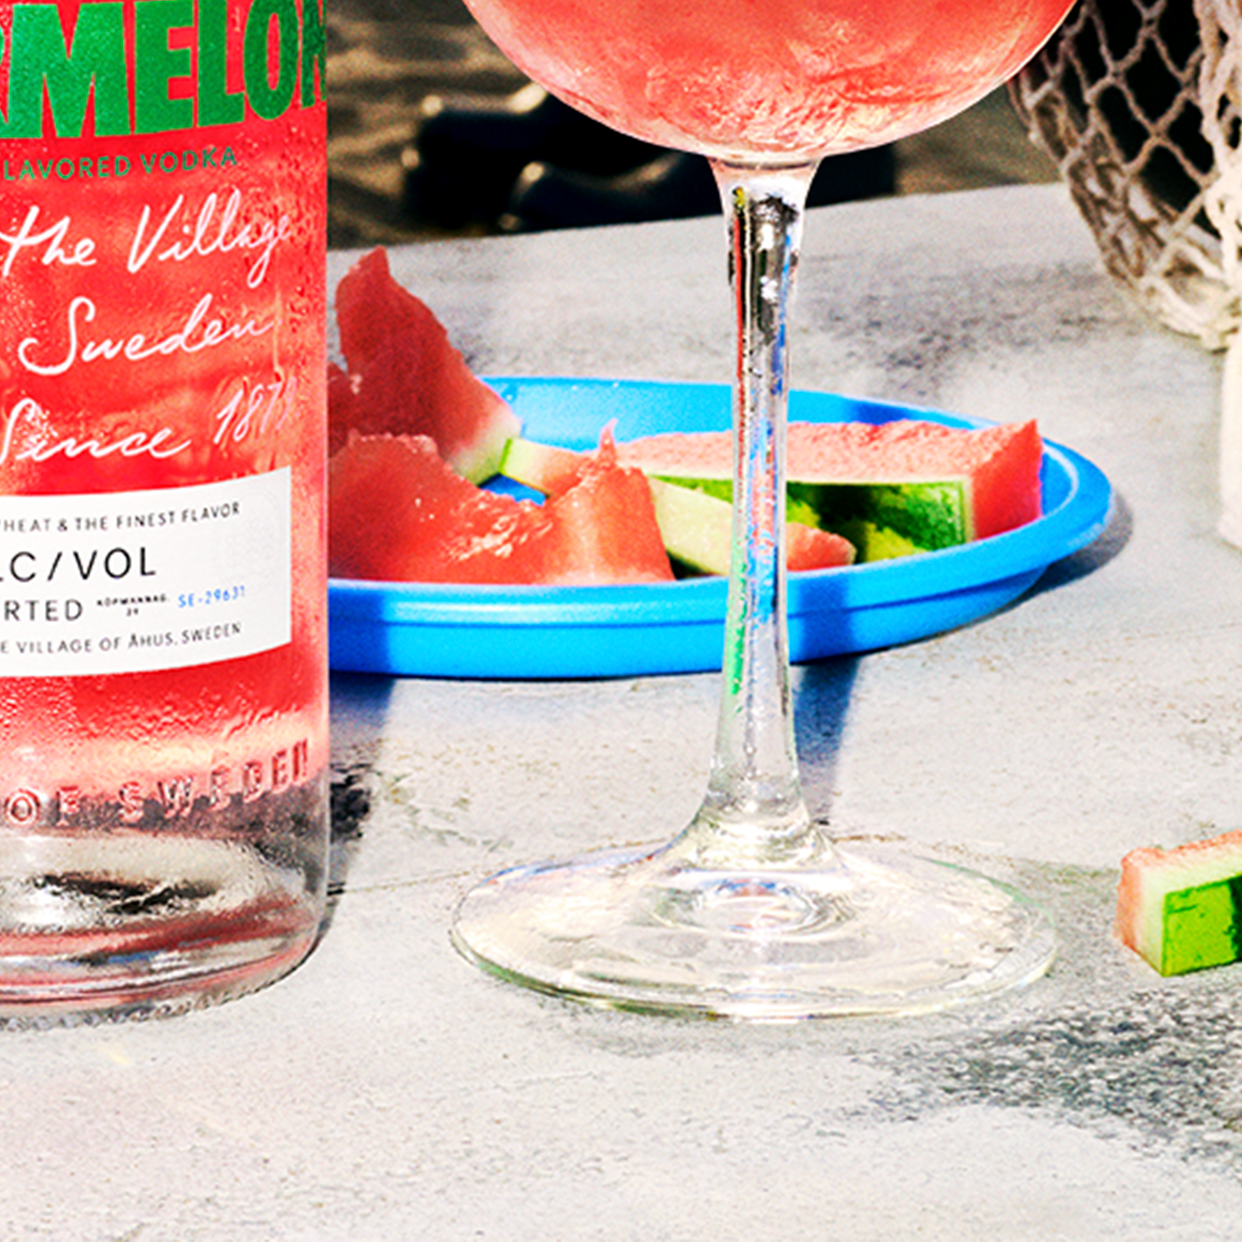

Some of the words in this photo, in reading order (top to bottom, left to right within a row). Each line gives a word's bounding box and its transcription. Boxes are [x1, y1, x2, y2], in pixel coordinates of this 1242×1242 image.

[141, 148, 235, 173] VODKA
[127, 188, 292, 289] Village
[18, 293, 274, 376] Sweden
[57, 519, 68, 532] &
[75, 516, 107, 531] THE
[116, 510, 175, 528] FINEST
[181, 501, 239, 522] FLAVOR
[16, 639, 91, 654] VILLAGE
[98, 637, 120, 651] OF
[181, 623, 241, 645] SWEDEN
[5, 785, 82, 827] OF
[120, 739, 309, 823] SWEDEN
